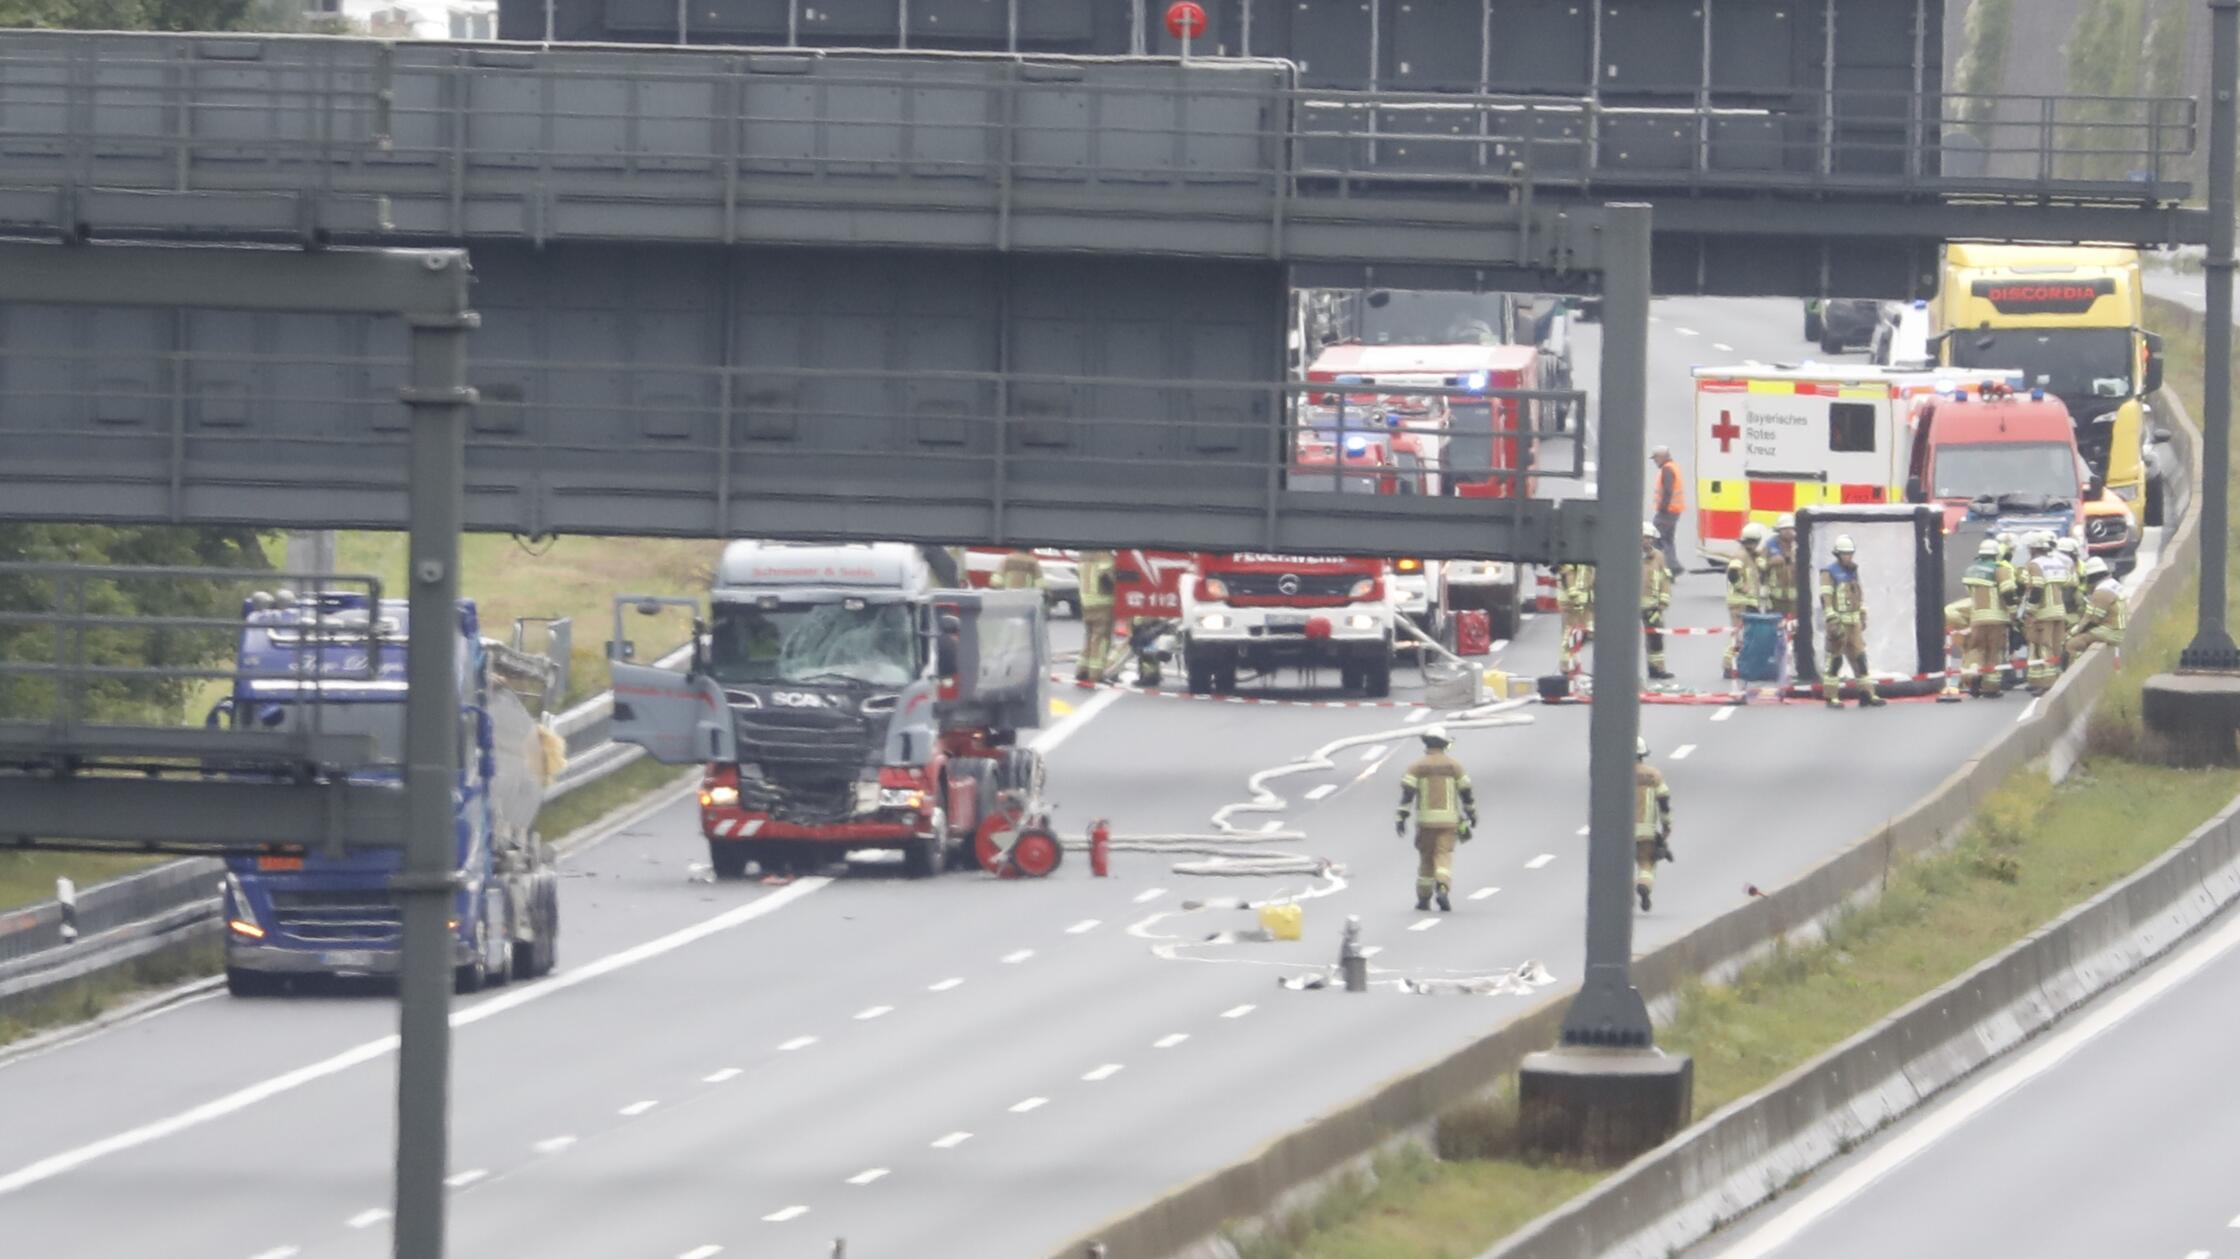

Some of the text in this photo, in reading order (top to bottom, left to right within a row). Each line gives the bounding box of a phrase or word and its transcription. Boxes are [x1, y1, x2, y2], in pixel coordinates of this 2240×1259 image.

[1988, 286, 2095, 301] DISCORDIA
[1746, 411, 1808, 426] Bayerisches
[1746, 427, 1776, 440] Rotes
[1746, 444, 1776, 456] Kreuz
[824, 566, 835, 576] &
[1148, 591, 1178, 607] 112
